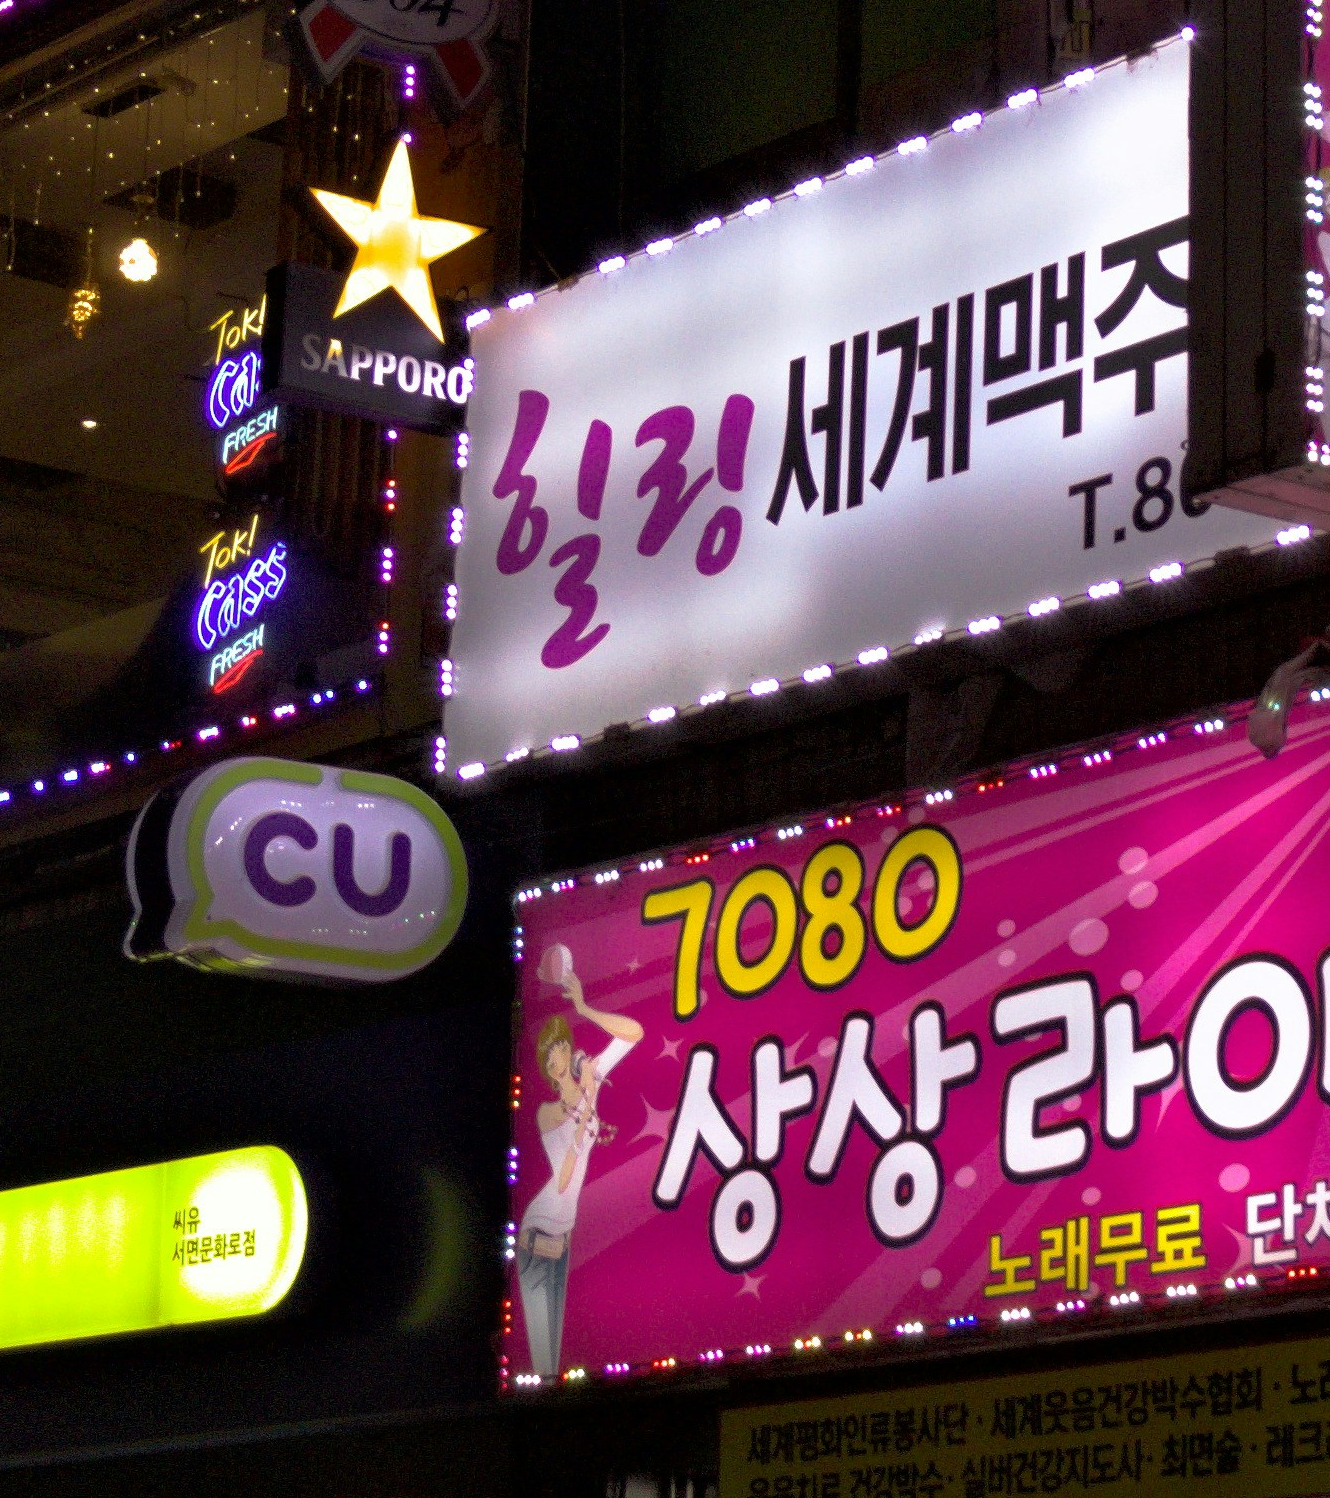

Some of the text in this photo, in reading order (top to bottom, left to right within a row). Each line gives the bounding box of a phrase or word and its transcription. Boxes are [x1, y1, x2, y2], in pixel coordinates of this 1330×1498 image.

[299, 332, 470, 407] SAPPORO
[221, 405, 279, 466] FRESH
[493, 215, 1190, 669] 힐링 세계맥주
[194, 539, 289, 653] Cass
[207, 621, 265, 691] FRESH
[242, 810, 412, 919] CU
[639, 823, 965, 1023] 7080
[171, 1228, 257, 1267] 서면문화로점
[172, 1205, 202, 1235] 씨유
[983, 1203, 1209, 1302] 노래무료
[990, 1367, 1264, 1440] 세계웃음건강박수협회
[1160, 1426, 1242, 1480] 최면술
